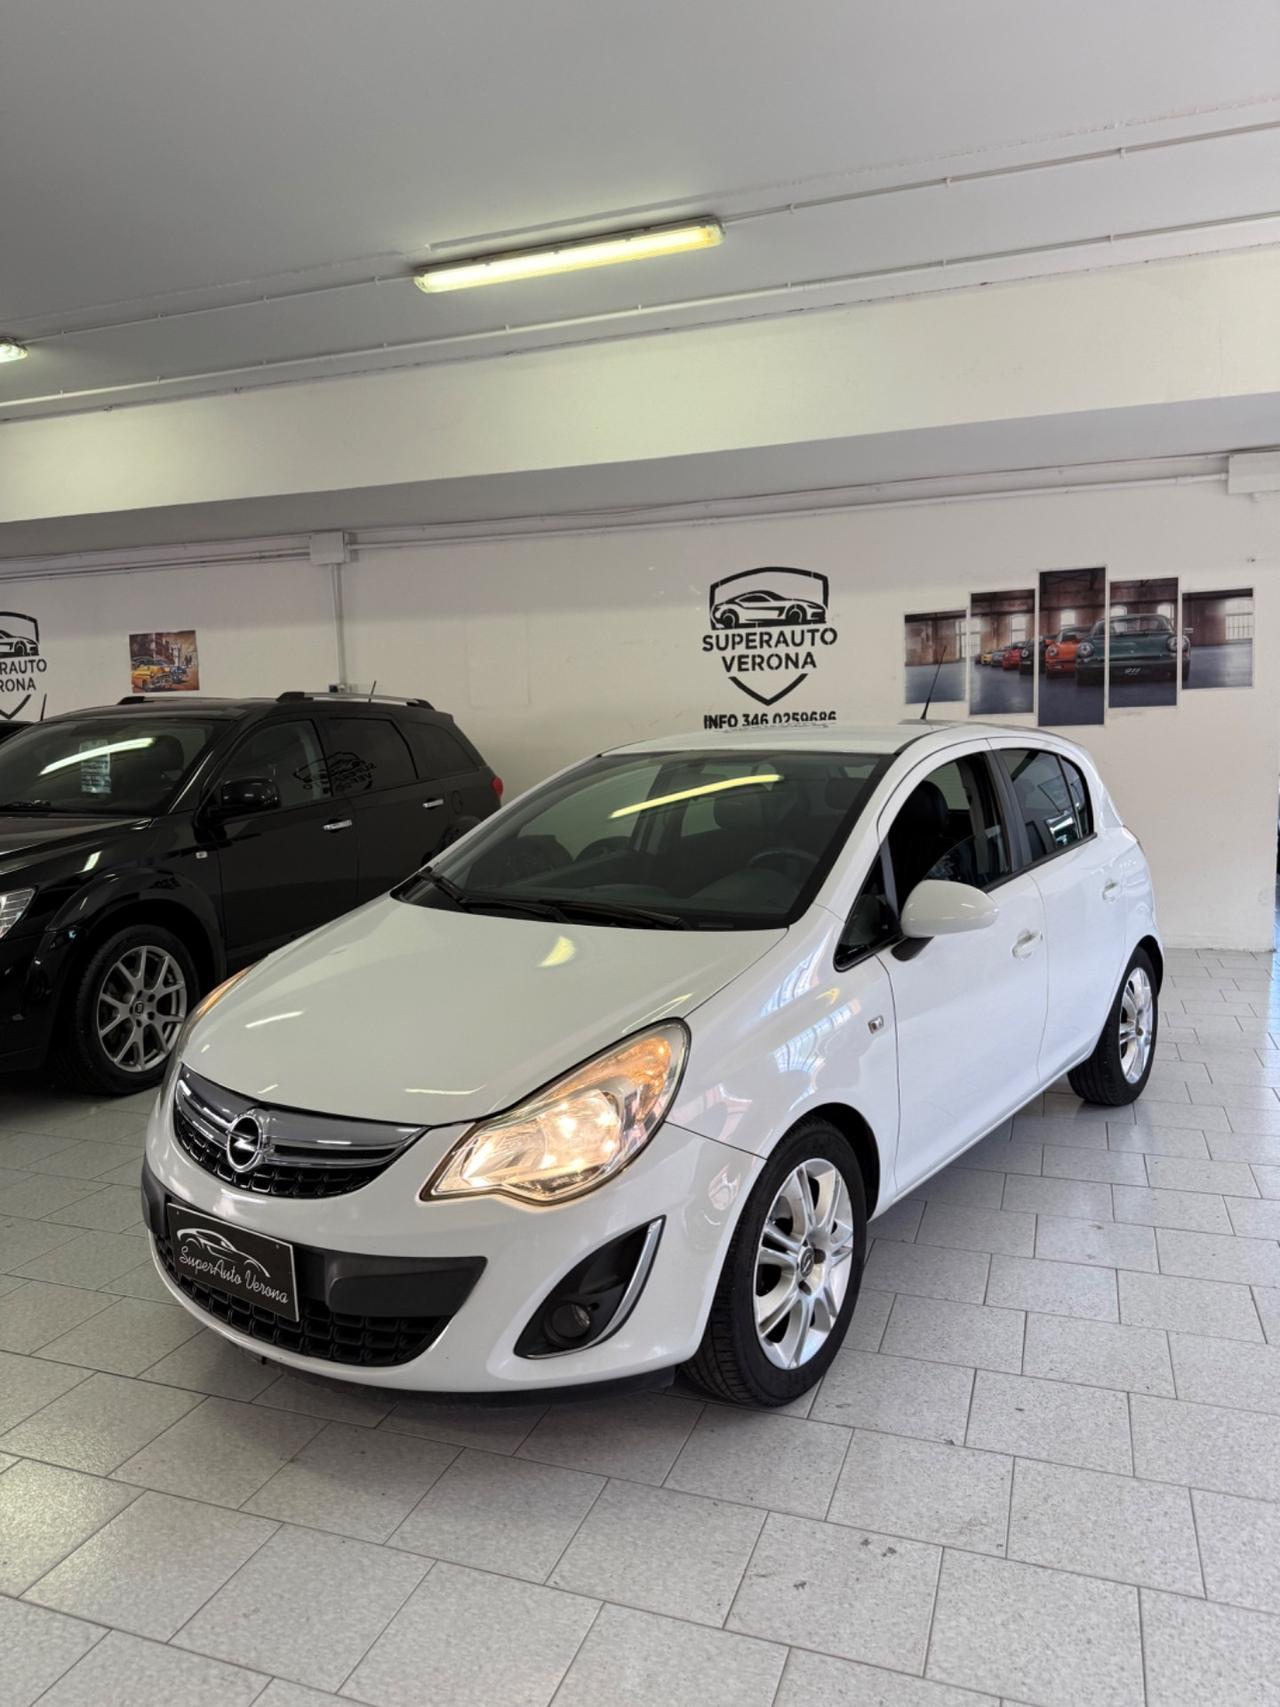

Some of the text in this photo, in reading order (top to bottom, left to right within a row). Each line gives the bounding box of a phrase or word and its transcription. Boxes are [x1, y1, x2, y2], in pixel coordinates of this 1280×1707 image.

[702, 627, 838, 652] SUPERAUTO
[721, 651, 817, 673] VERONA
[704, 714, 739, 729] INFO
[742, 713, 769, 727] 346
[179, 1246, 289, 1304] SuperAuto Verona
